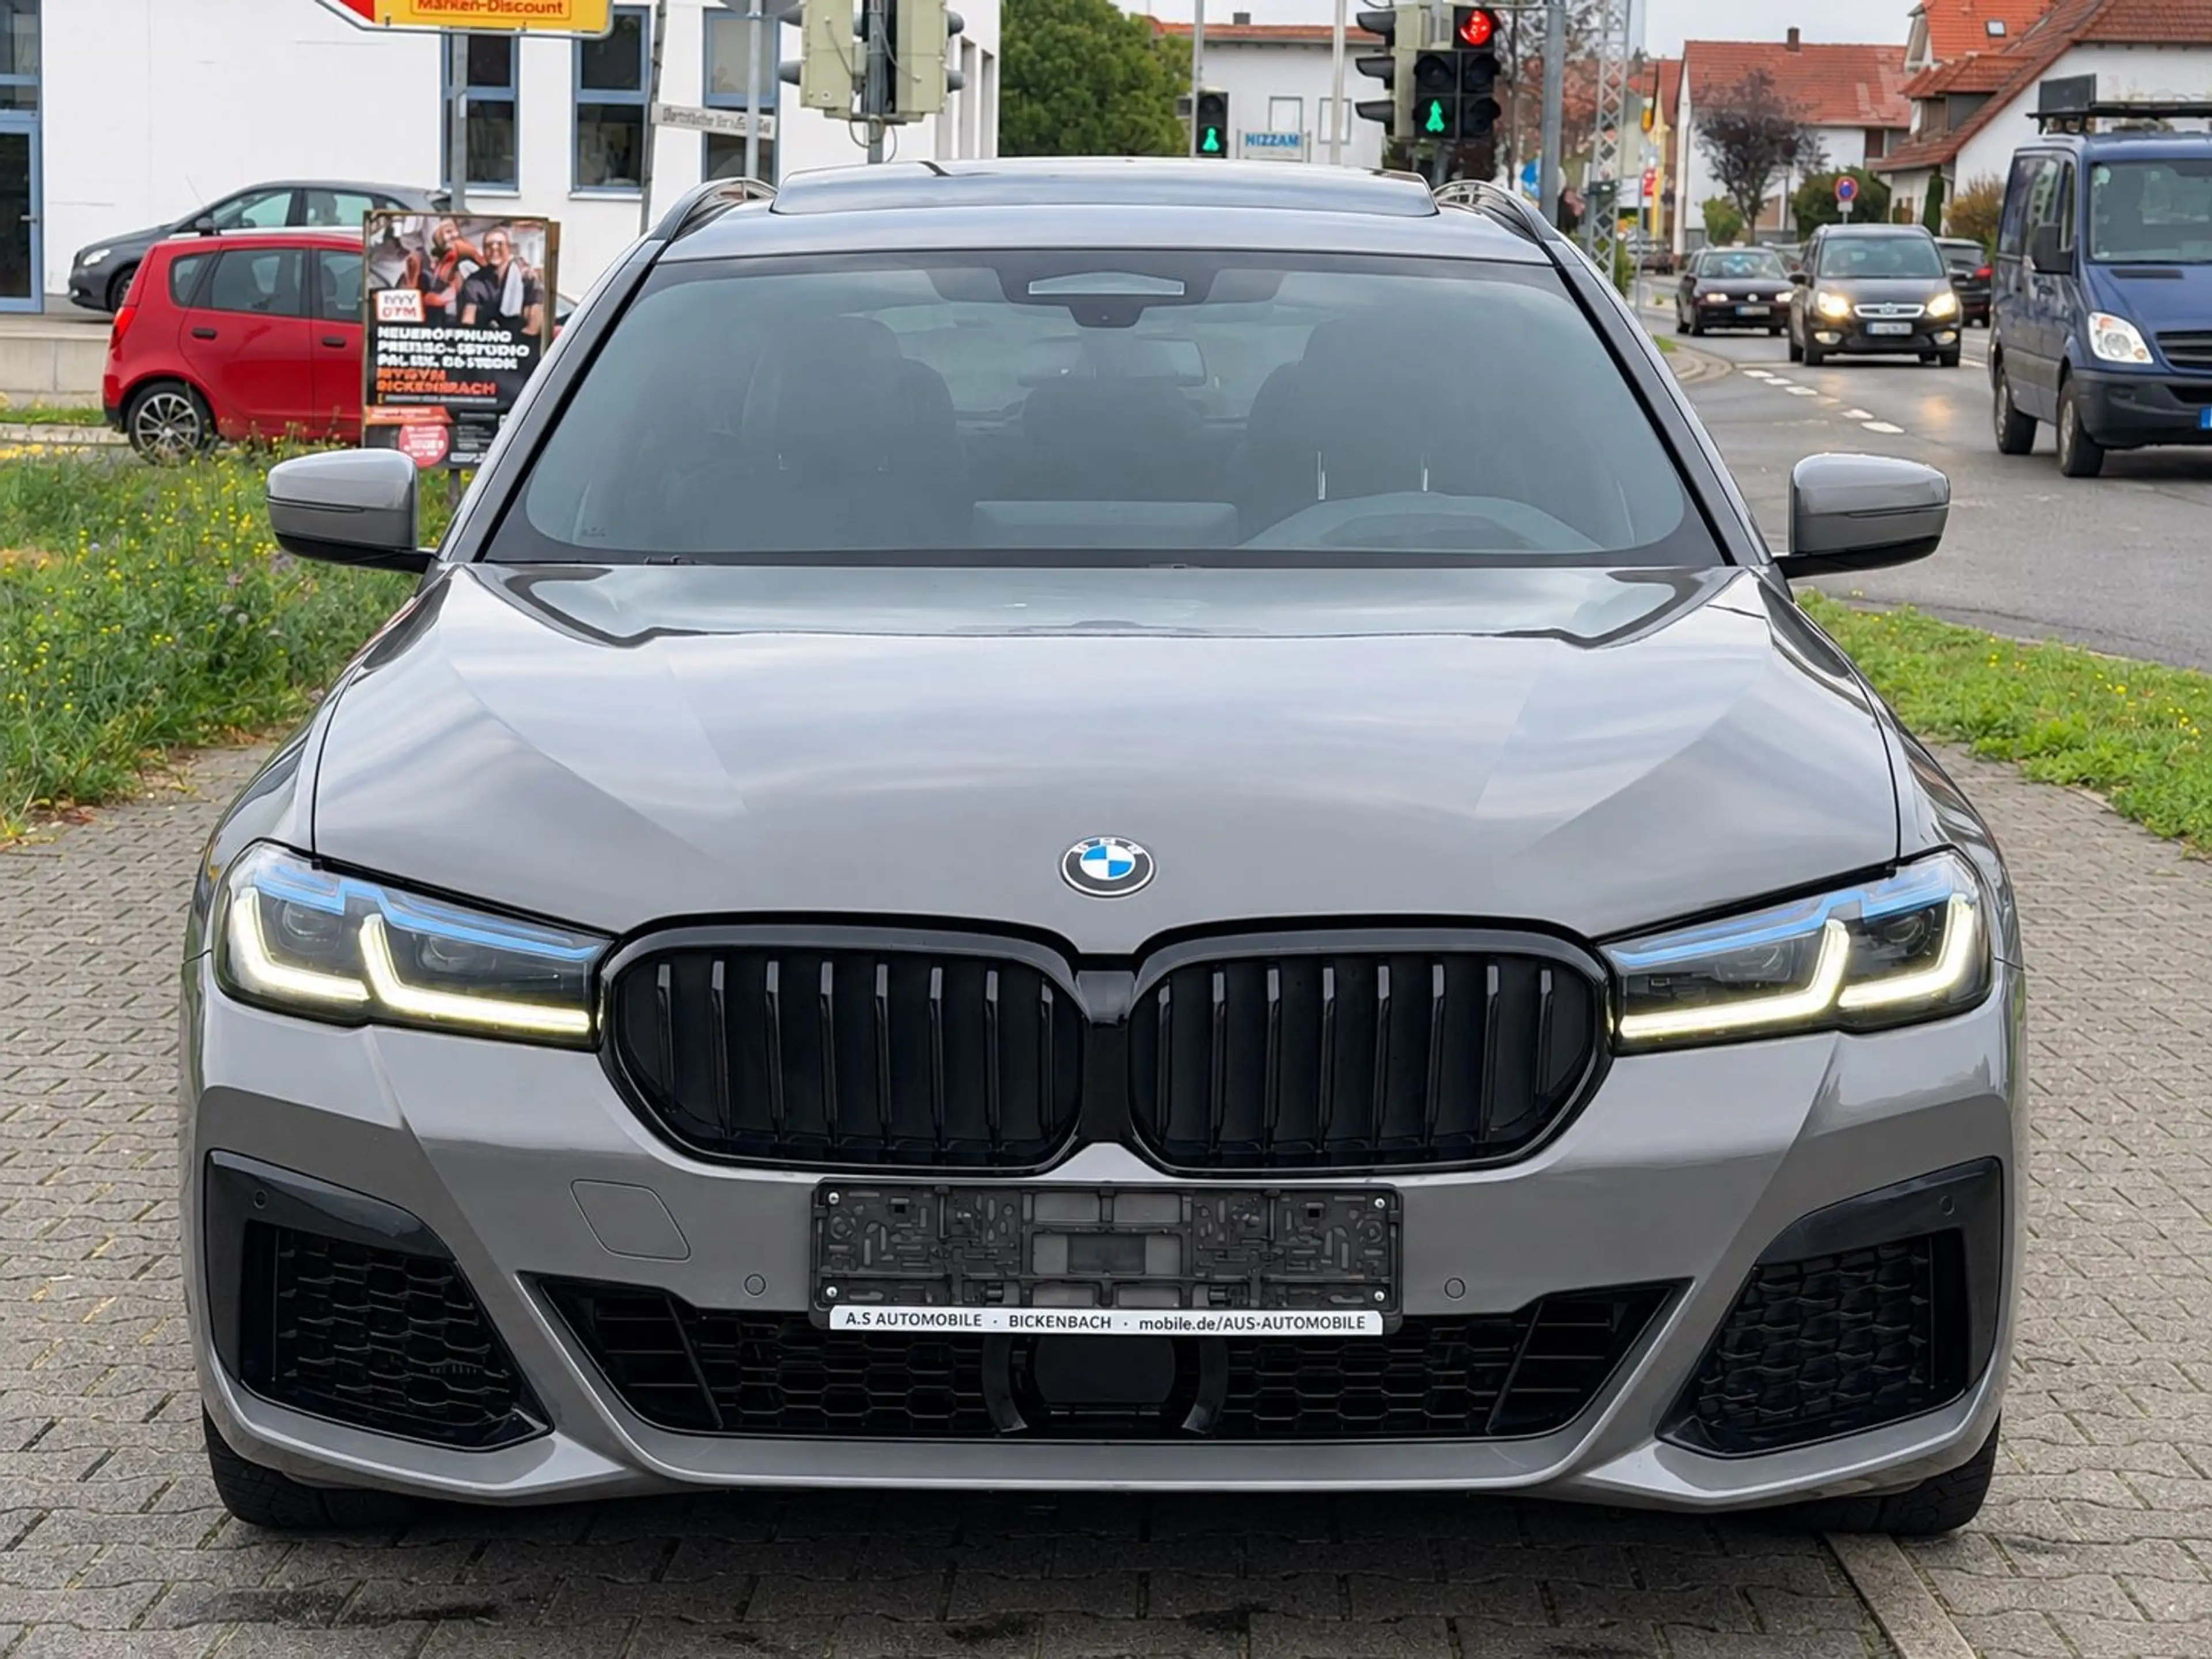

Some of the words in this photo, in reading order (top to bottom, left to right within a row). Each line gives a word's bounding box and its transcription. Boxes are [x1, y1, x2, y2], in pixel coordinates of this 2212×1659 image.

[846, 1312, 870, 1325] A.S
[876, 1313, 982, 1327] AUTOMOBILE
[1009, 1315, 1111, 1330] BICKENBACH
